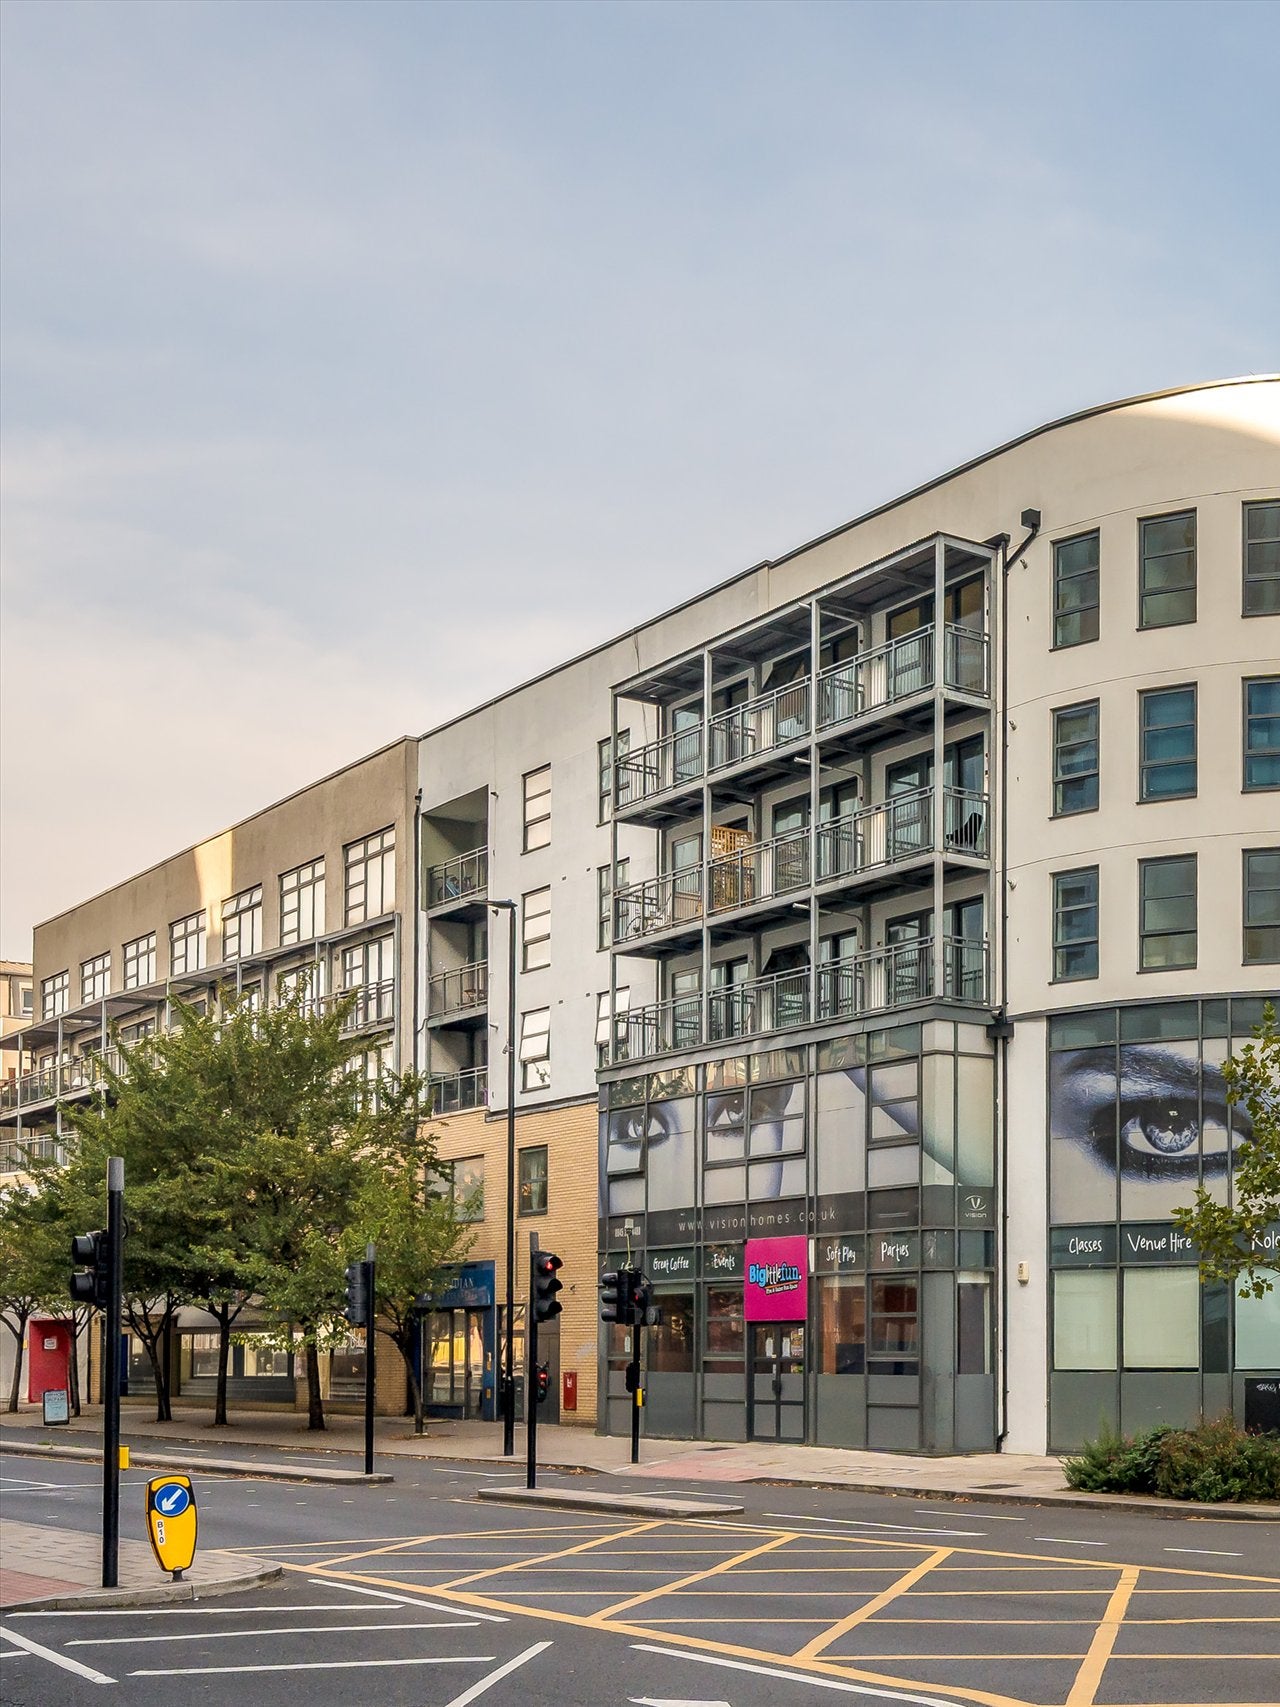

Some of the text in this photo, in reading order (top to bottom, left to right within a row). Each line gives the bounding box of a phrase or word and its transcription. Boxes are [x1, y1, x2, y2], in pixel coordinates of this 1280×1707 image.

[678, 1207, 836, 1231] www.visionhomes.co.uk
[881, 1242, 909, 1262] Parties
[1068, 1236, 1103, 1255] Classes
[1127, 1232, 1192, 1253] Venue Hire
[712, 1253, 736, 1269] Events
[826, 1245, 856, 1264] Soft Play
[653, 1257, 669, 1274] Great
[670, 1256, 689, 1271] Coffee
[157, 1520, 165, 1544] B10
